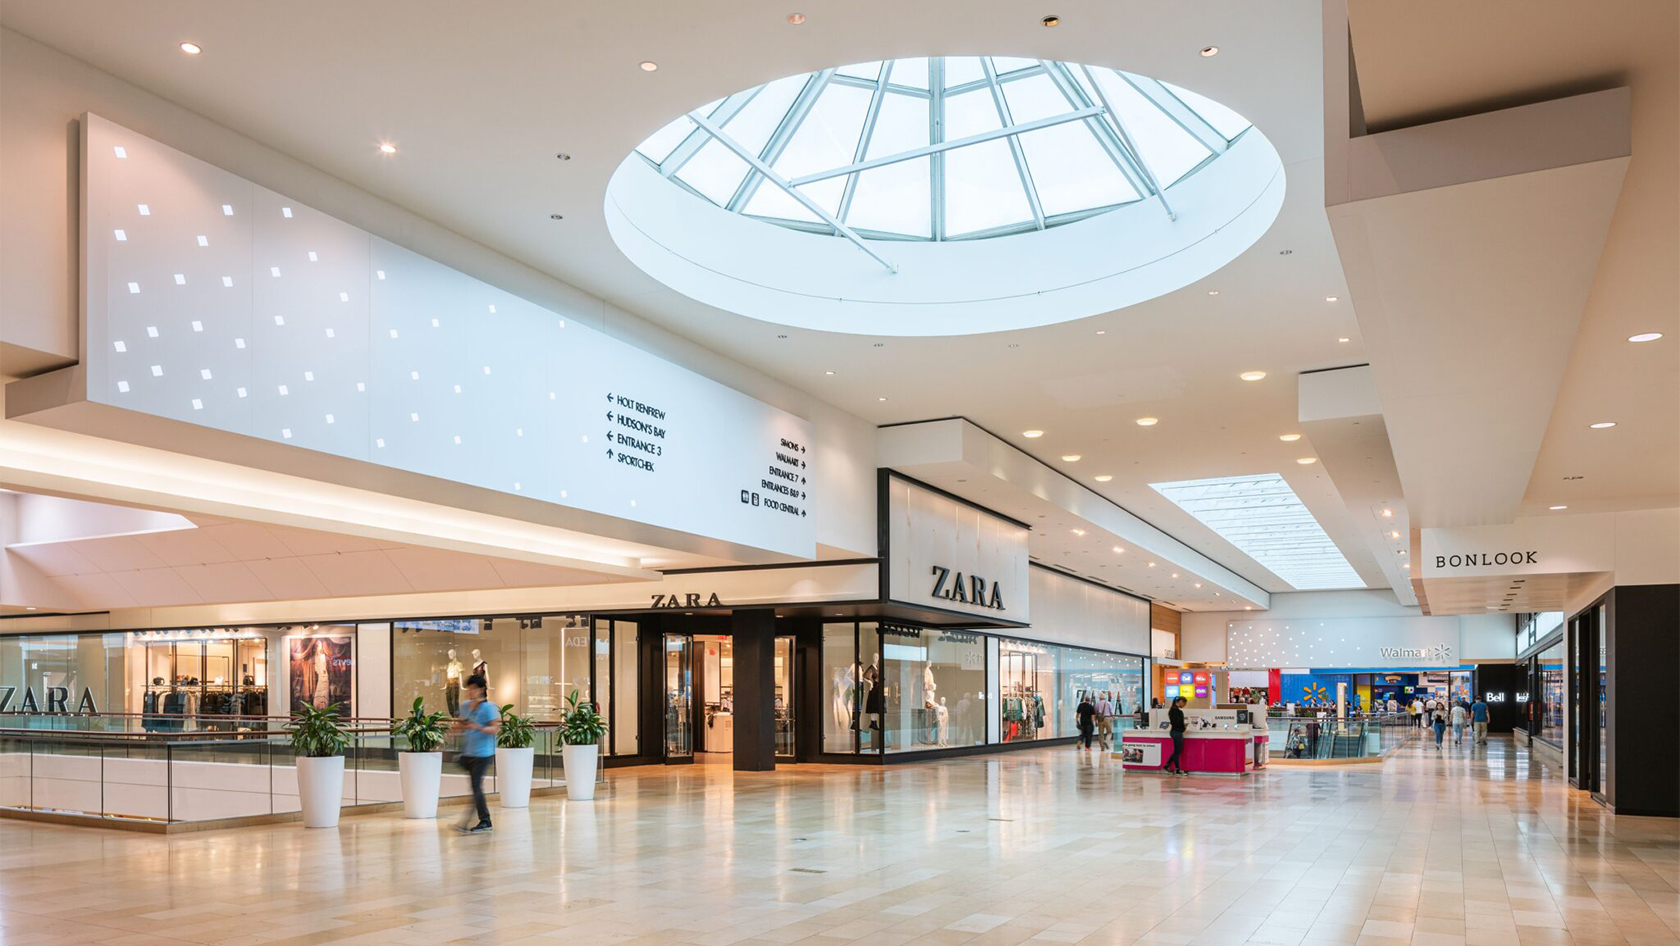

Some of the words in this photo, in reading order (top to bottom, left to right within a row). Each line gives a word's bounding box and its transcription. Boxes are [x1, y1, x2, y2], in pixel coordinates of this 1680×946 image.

[617, 395, 634, 409] HOLT
[636, 402, 666, 420] RENFREW
[617, 414, 652, 435] HUDSON'S
[653, 426, 666, 439] BAY
[617, 433, 655, 454] ENTRANCE
[657, 446, 662, 456] 3
[780, 438, 799, 452] SIMONS
[617, 452, 654, 472] SPORTCHEK
[775, 451, 799, 467] WALMART
[768, 465, 794, 482] ENTRANCE
[795, 474, 799, 482] 7
[761, 479, 789, 495] ENTRANCES
[763, 498, 779, 510] FOOD
[779, 502, 799, 516] CENTRAL
[1435, 551, 1538, 568] BONLOOK
[931, 565, 1006, 610] ZARA
[651, 592, 723, 608] ZARA
[0, 686, 103, 716] ZARA
[1486, 692, 1505, 702] Bell
